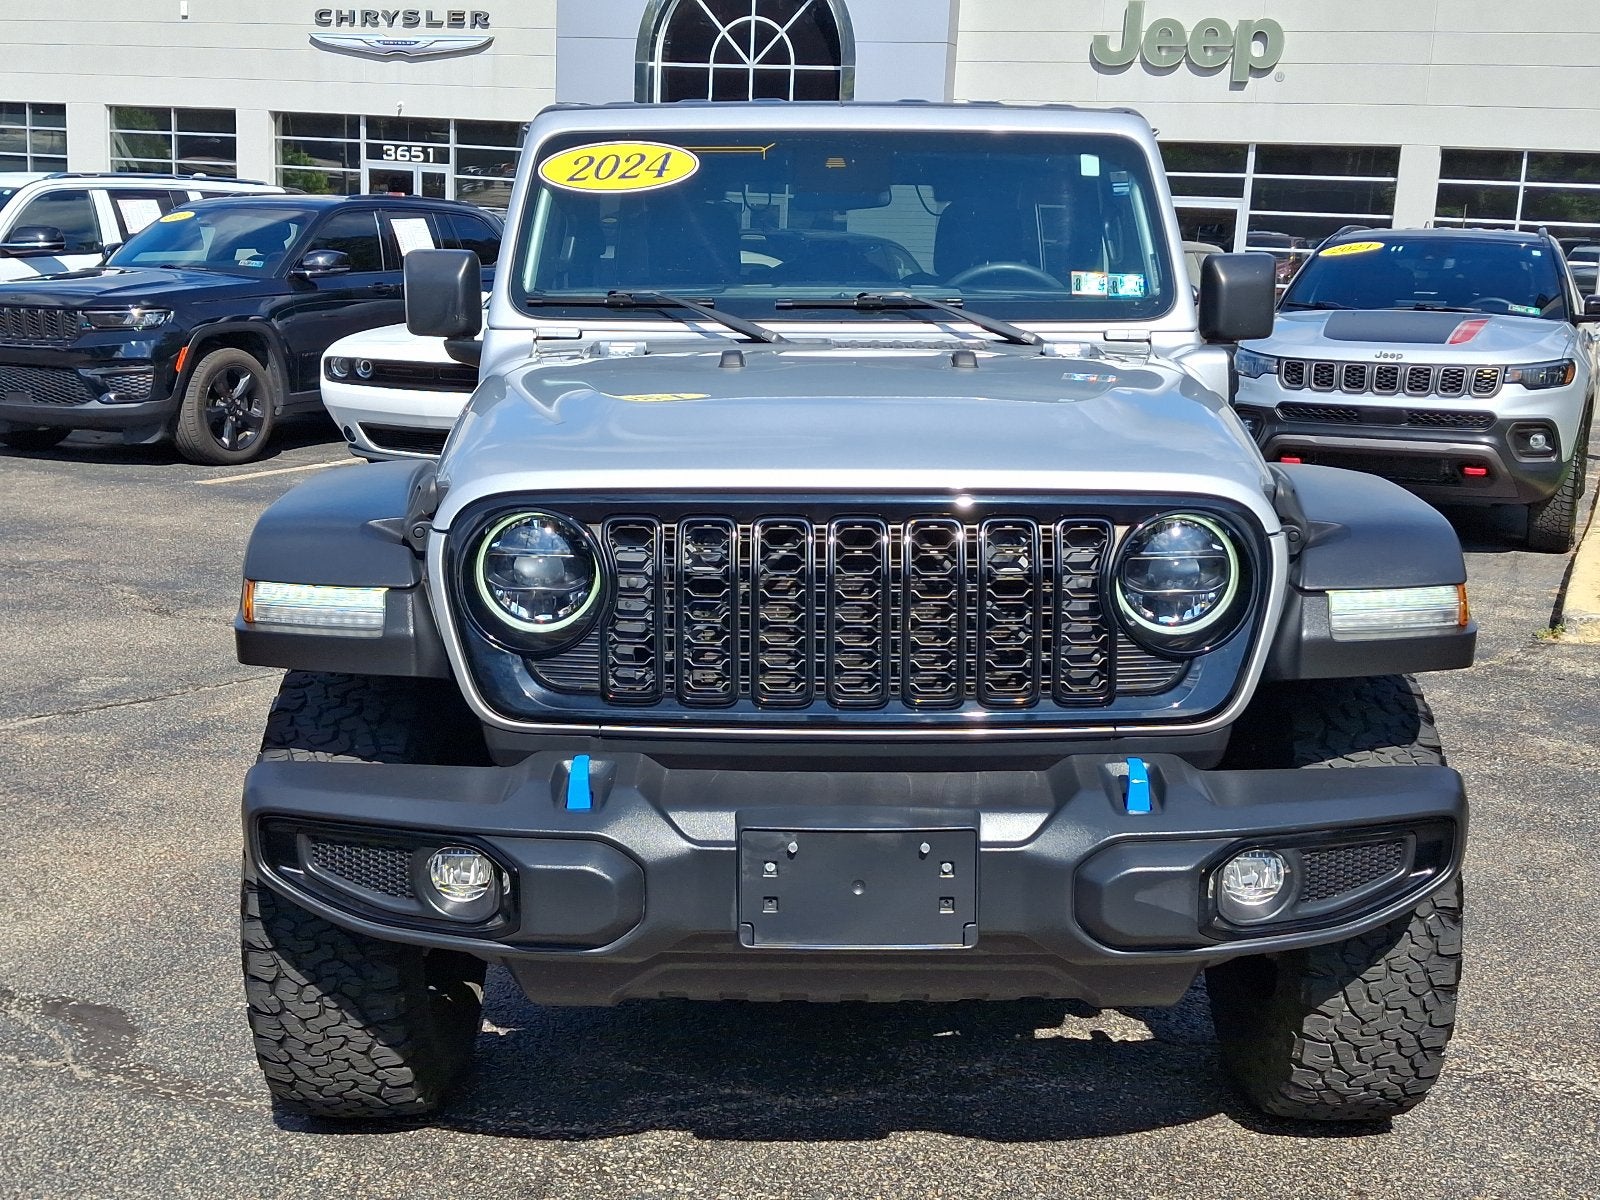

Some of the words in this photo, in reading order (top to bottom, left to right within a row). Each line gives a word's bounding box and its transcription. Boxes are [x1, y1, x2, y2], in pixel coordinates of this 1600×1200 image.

[314, 8, 490, 29] CHRYSLER
[1090, 0, 1285, 88] Jeep
[382, 144, 434, 163] 3651
[565, 151, 673, 183] 2024
[1374, 350, 1404, 361] Jeep
